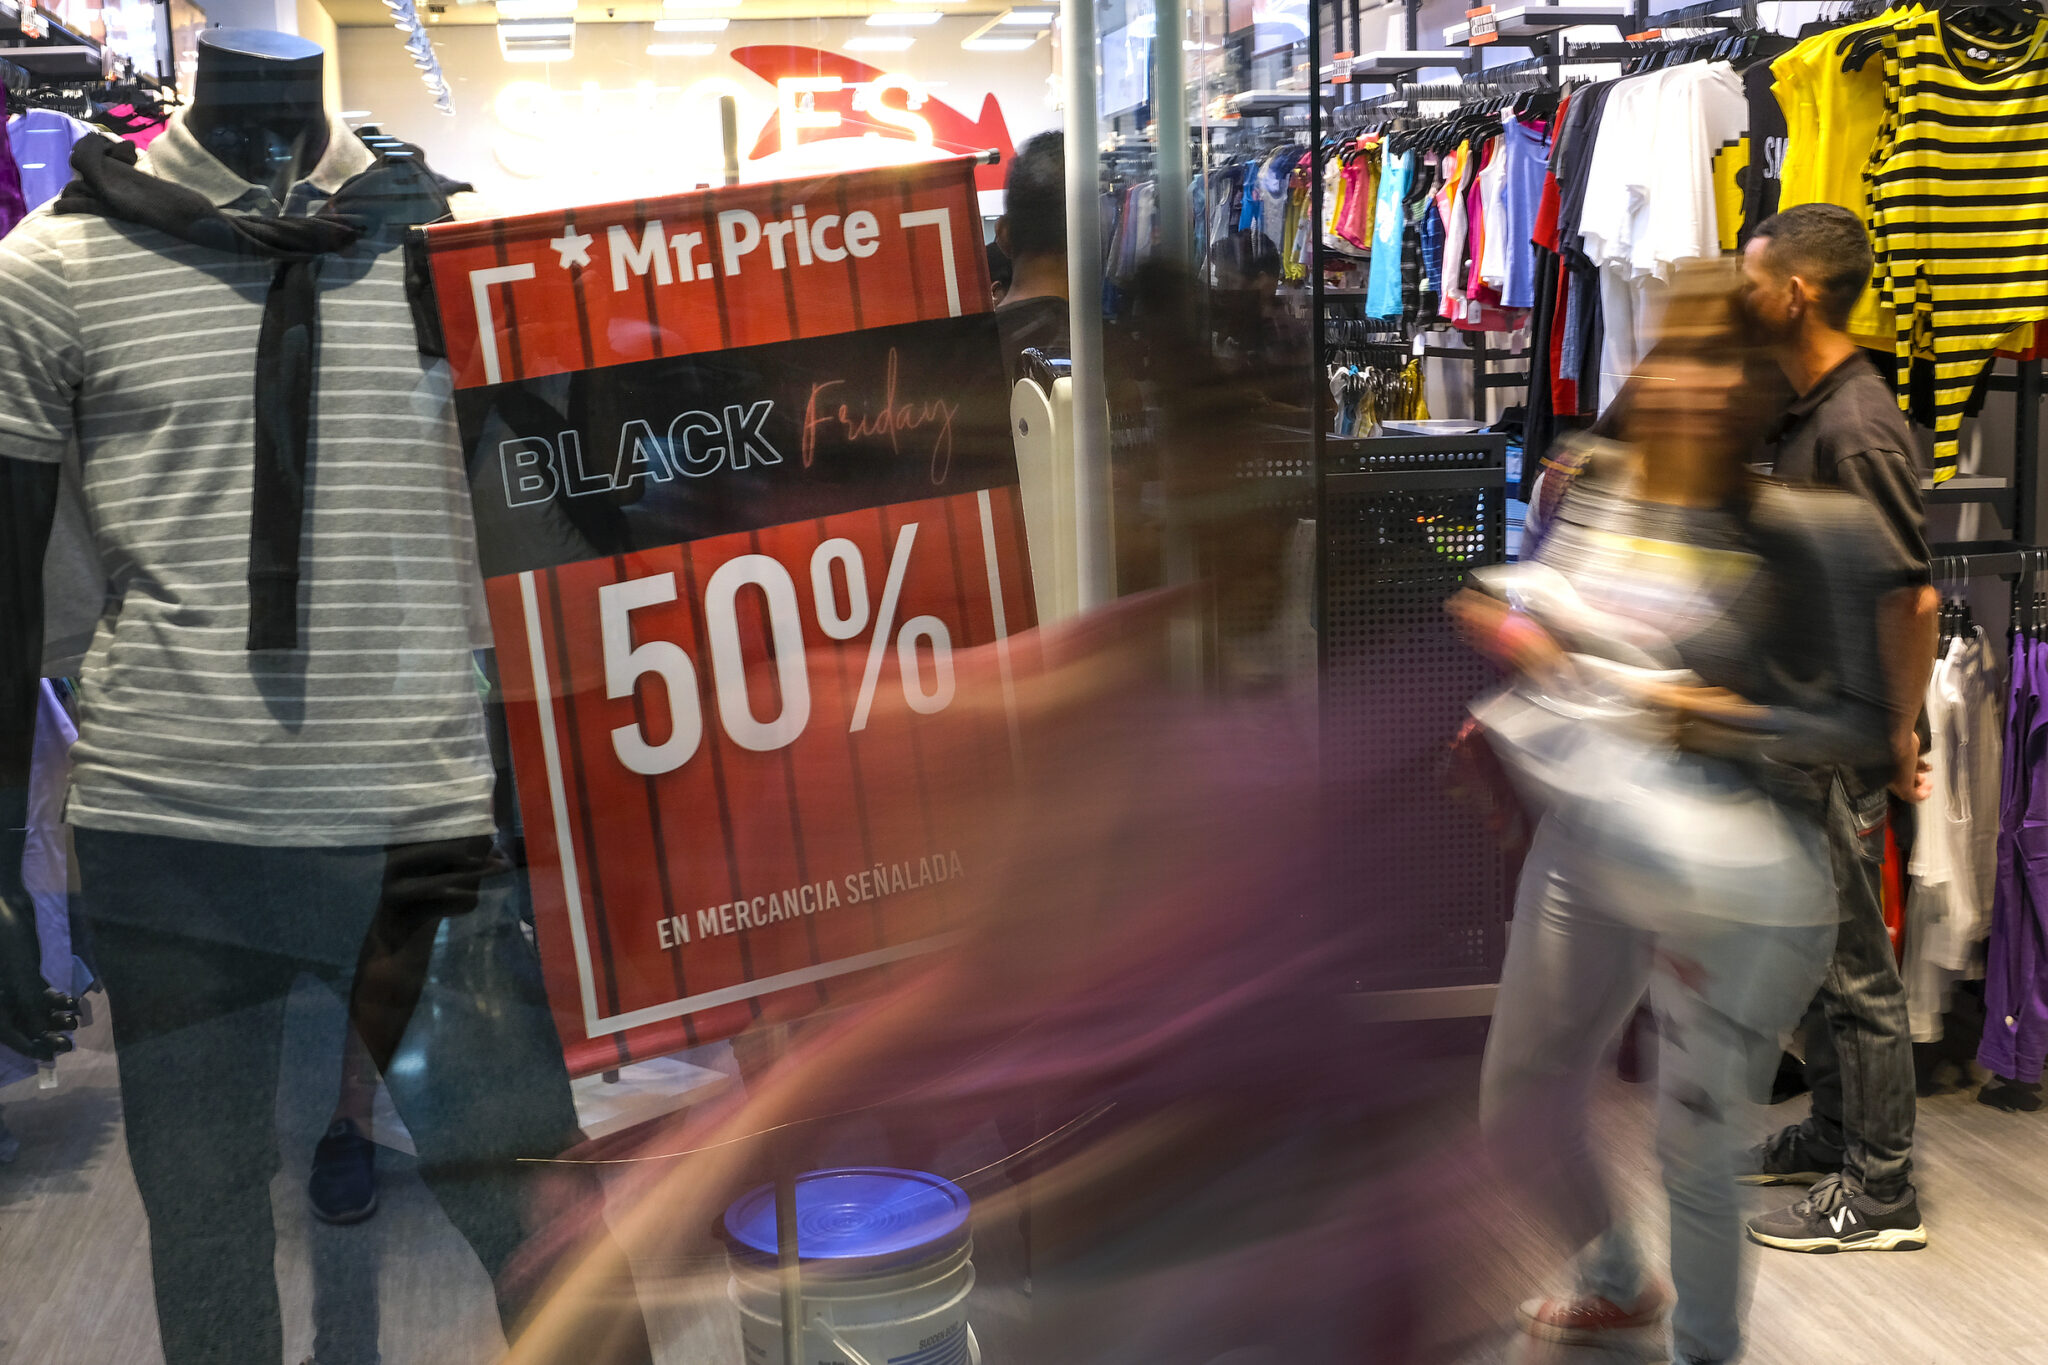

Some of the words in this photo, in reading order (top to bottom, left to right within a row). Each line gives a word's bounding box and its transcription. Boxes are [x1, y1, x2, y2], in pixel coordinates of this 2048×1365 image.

[499, 400, 783, 508] BLACK
[801, 347, 959, 486] Friday
[598, 522, 956, 776] 50%
[656, 913, 691, 951] EN
[696, 879, 841, 939] MERCANCIA
[844, 849, 965, 905] SEÑALADA
